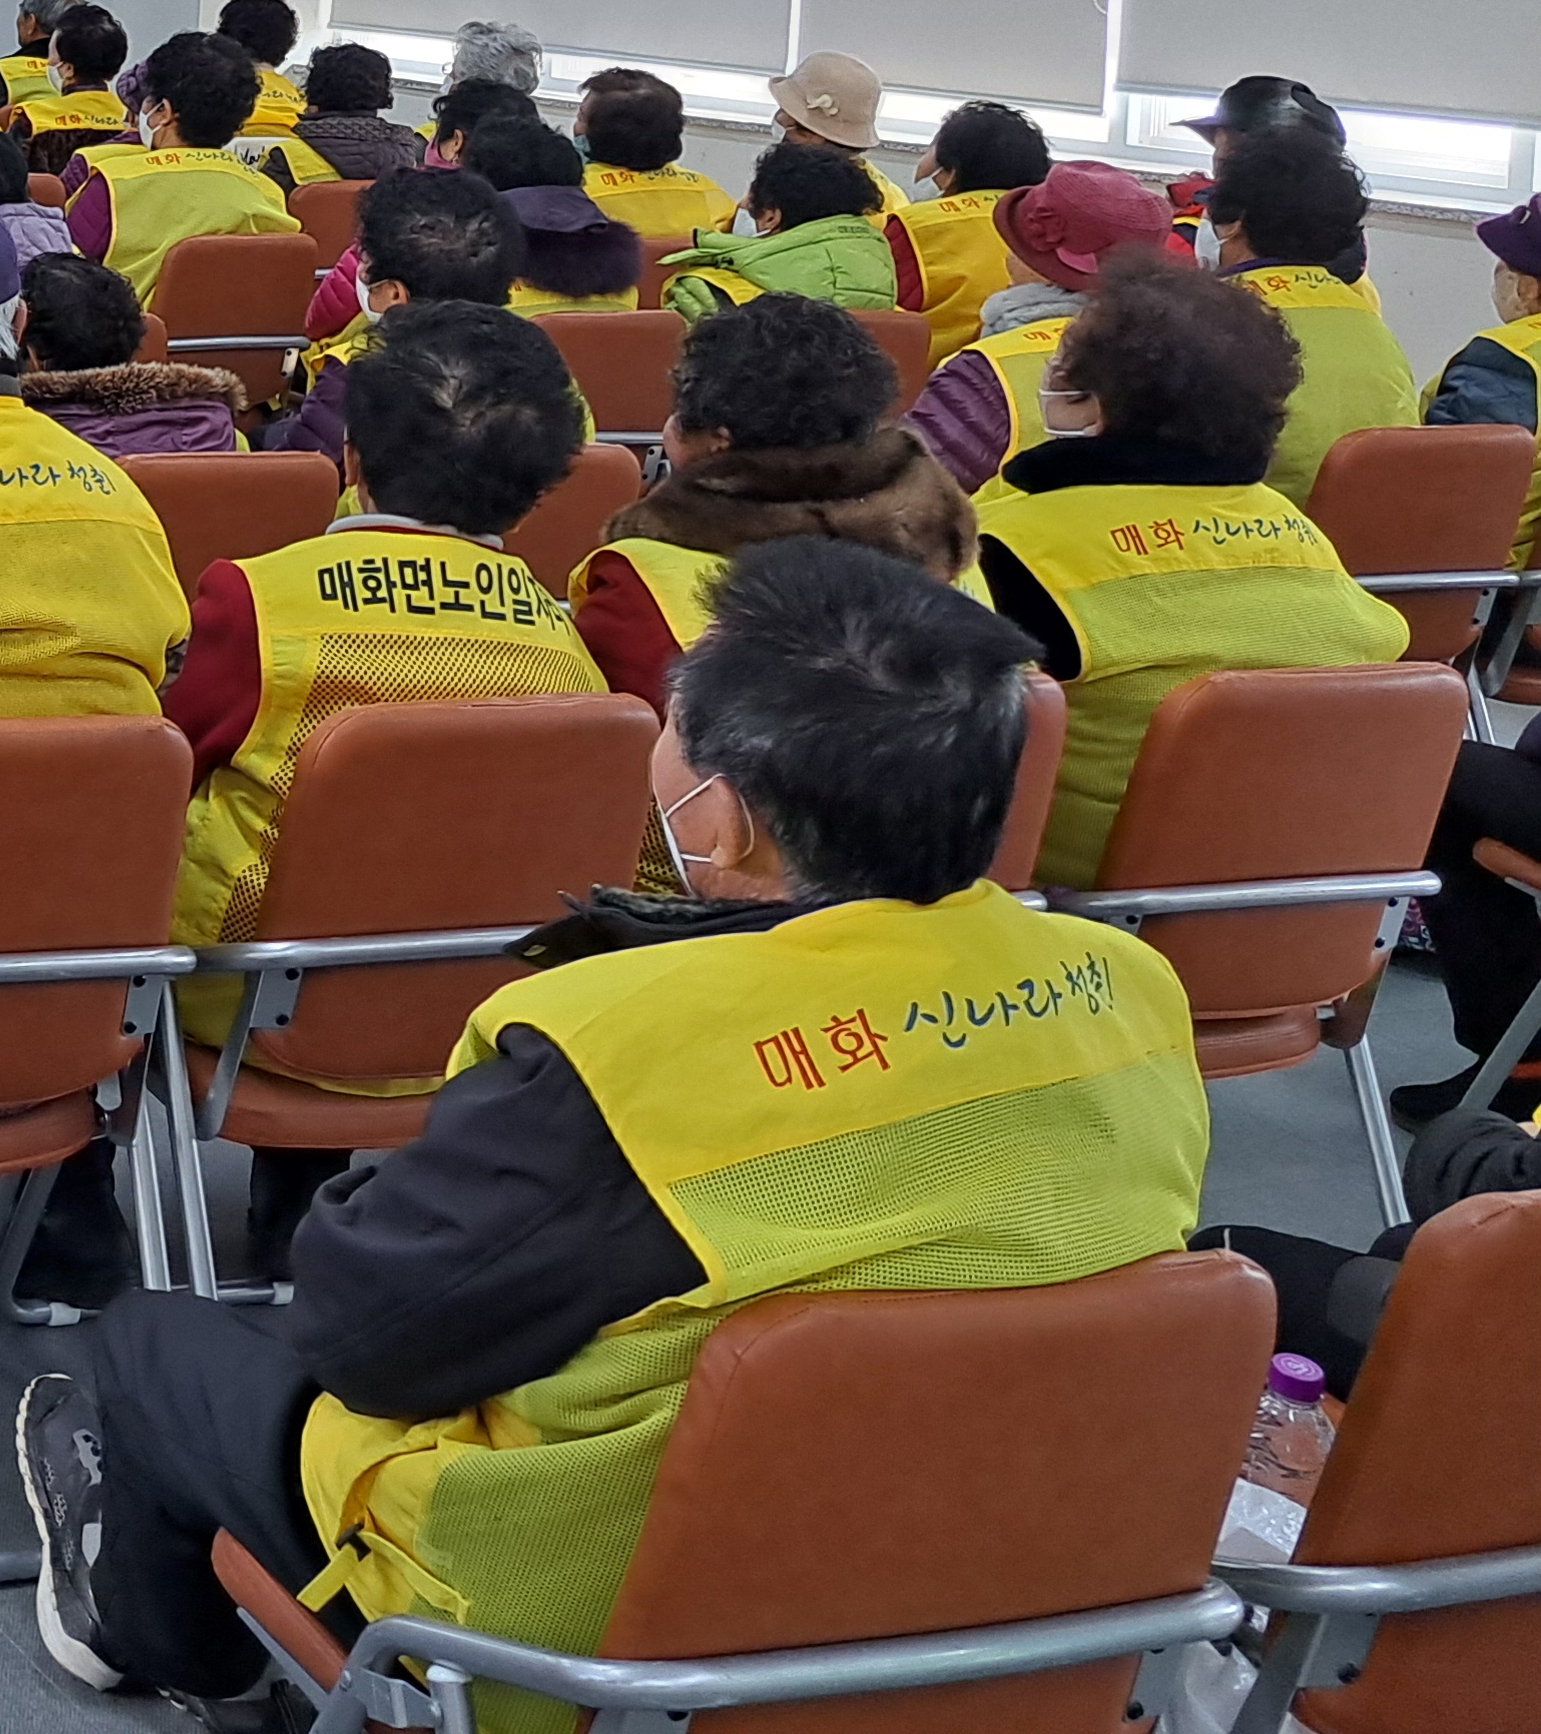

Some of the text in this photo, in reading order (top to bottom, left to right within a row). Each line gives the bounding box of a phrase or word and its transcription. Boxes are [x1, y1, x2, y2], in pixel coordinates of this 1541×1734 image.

[1109, 517, 1186, 557] 매화
[1192, 516, 1282, 546] 신나라
[752, 1007, 892, 1091] 매화
[902, 977, 1064, 1049] 신나라
